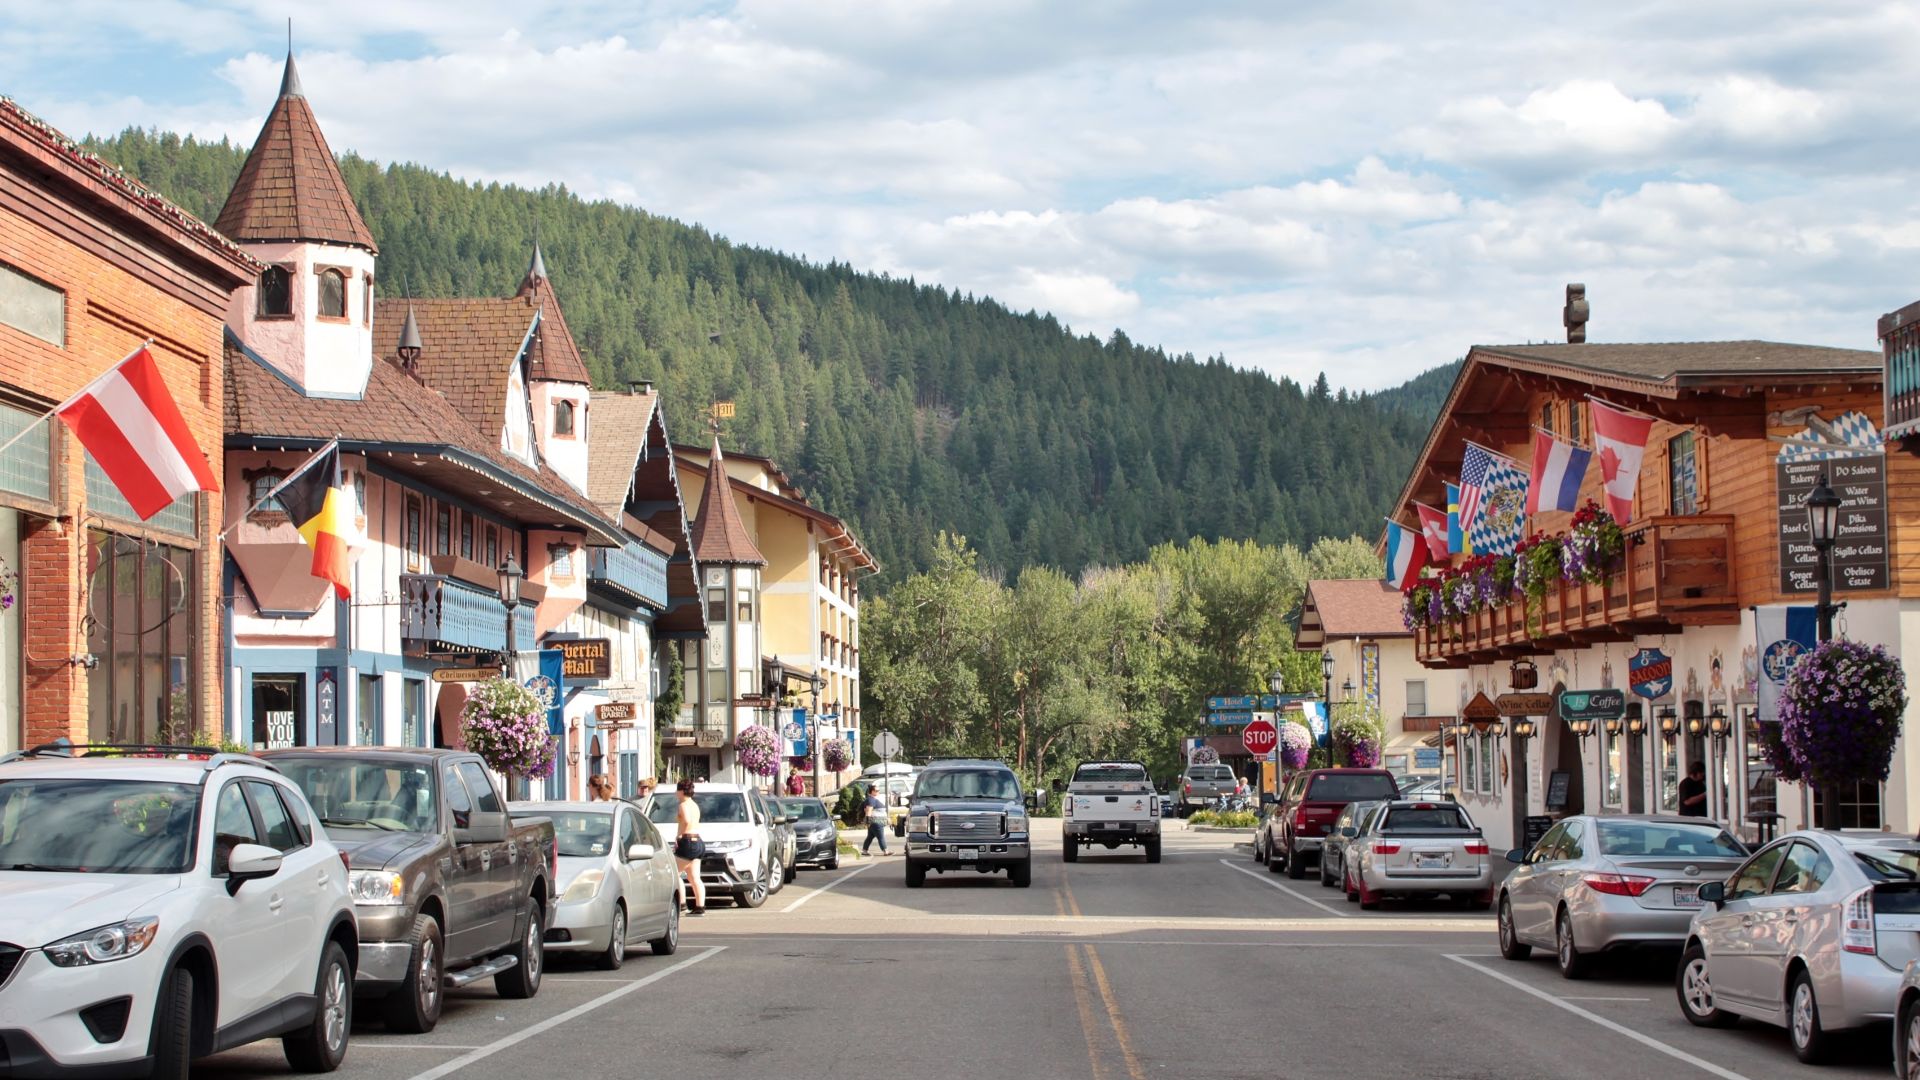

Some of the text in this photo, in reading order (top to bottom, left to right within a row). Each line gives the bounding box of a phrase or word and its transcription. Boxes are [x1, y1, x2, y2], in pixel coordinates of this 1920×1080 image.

[1851, 465, 1877, 475] Saloon
[1790, 475, 1816, 484] Bakery
[1845, 486, 1869, 495] Water
[1857, 495, 1878, 505] Wine
[1839, 524, 1878, 536] Provisions
[1858, 545, 1883, 555] Cellars
[1848, 577, 1872, 586] Estate
[562, 659, 595, 674] Mall
[1498, 698, 1550, 709] Wine Cellar
[1590, 695, 1622, 708] Coffee
[600, 705, 629, 713] BROKEN
[266, 711, 295, 725] LOVE
[601, 711, 627, 719] BARREL
[1219, 713, 1250, 722] Brewery
[267, 725, 295, 741] YOU
[1245, 731, 1275, 744] STOP
